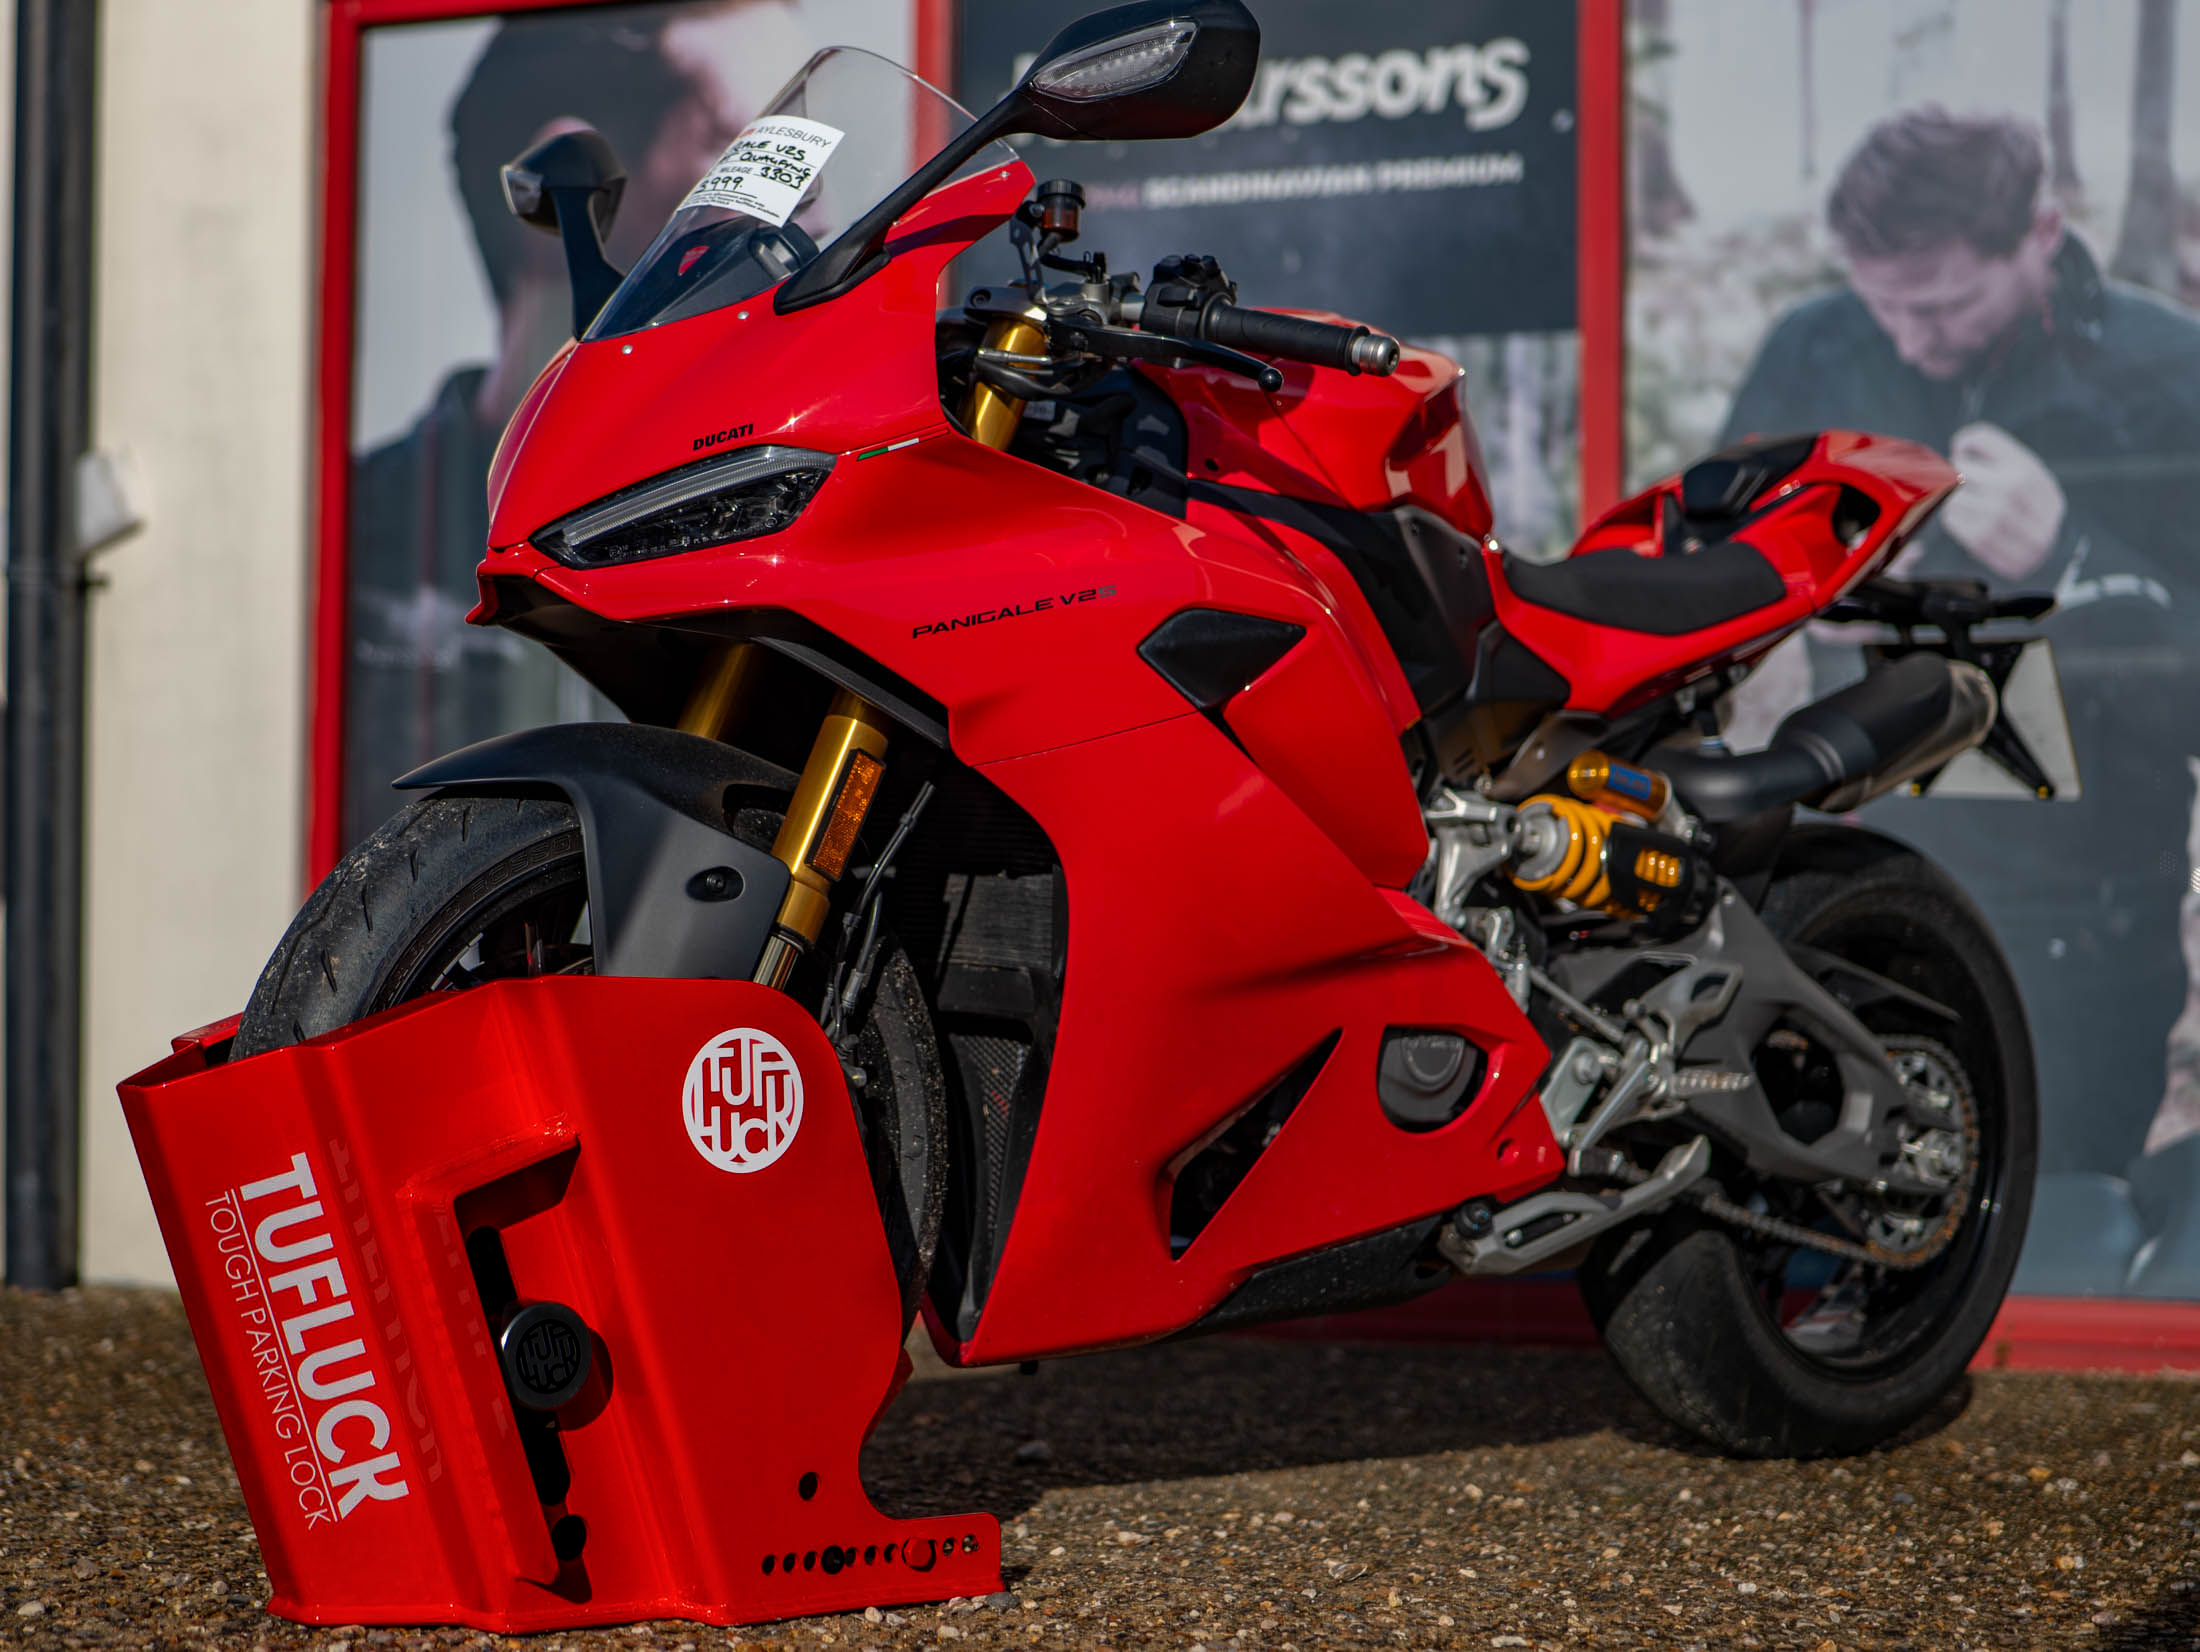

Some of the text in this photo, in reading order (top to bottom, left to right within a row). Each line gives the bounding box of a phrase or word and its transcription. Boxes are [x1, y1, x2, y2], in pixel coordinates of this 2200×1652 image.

[757, 126, 832, 147] AYLESBURY
[761, 166, 805, 190] 3303
[692, 424, 754, 451] DUCATI
[912, 597, 1054, 639] PANIGALE
[240, 1152, 410, 1519] TUFLUCK
[206, 1190, 331, 1531] TOUGH PARKING LOCK
